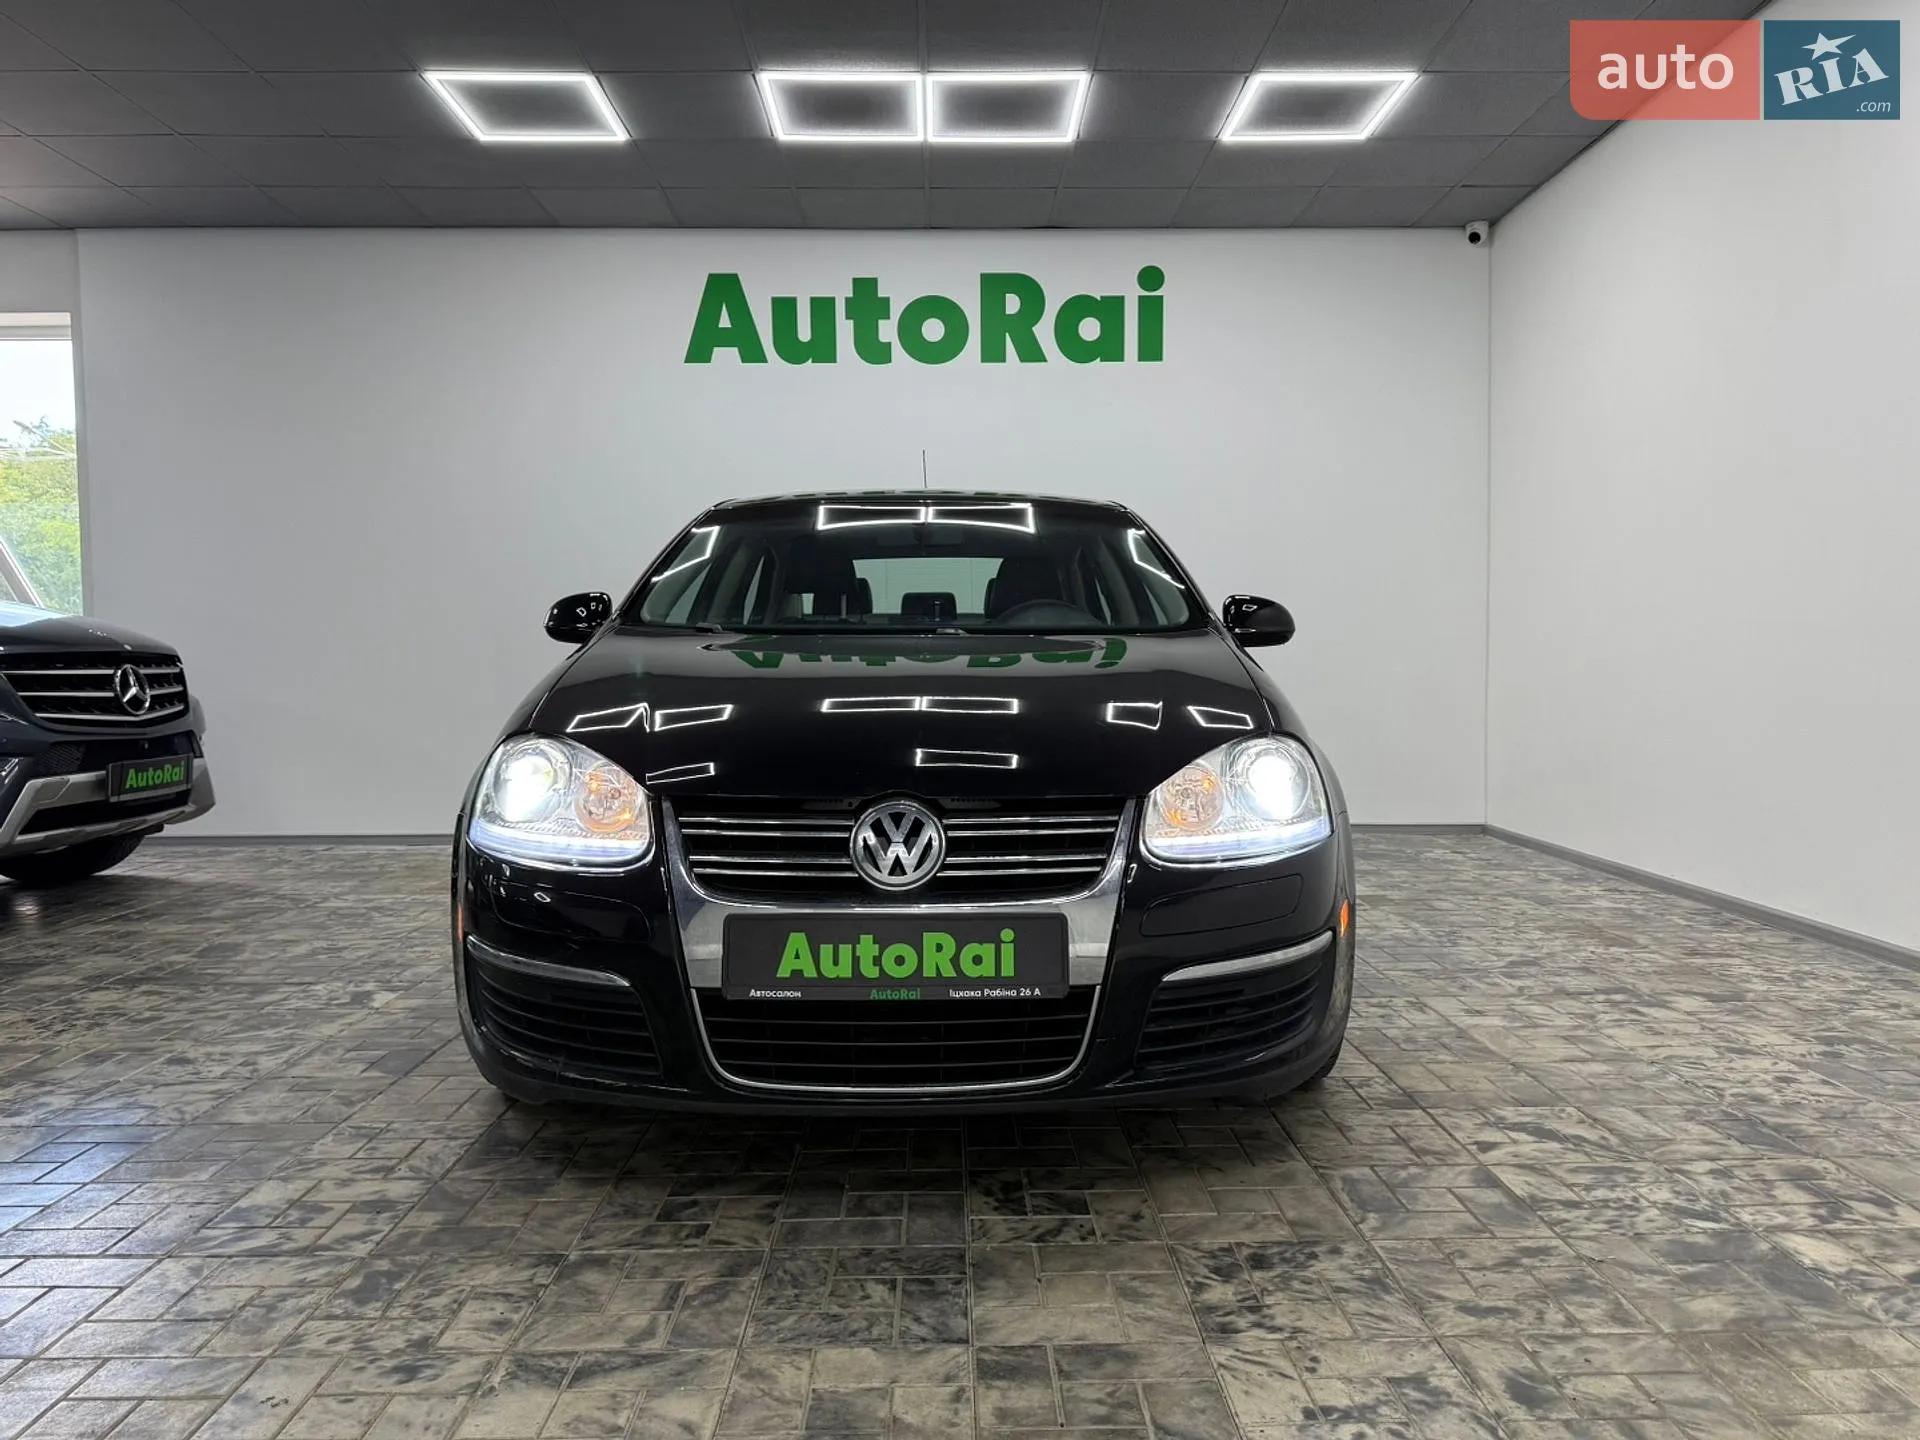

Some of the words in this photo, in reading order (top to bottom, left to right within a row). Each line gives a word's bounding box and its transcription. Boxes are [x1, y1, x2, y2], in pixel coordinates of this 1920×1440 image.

[683, 265, 1166, 365] AutoRai
[125, 760, 185, 789] AutoRai
[775, 927, 1016, 979] AutoRai
[749, 988, 802, 998] Автосалон
[869, 987, 921, 1000] AutoRai
[984, 987, 1017, 997] Рабіна
[1019, 987, 1031, 996] 26
